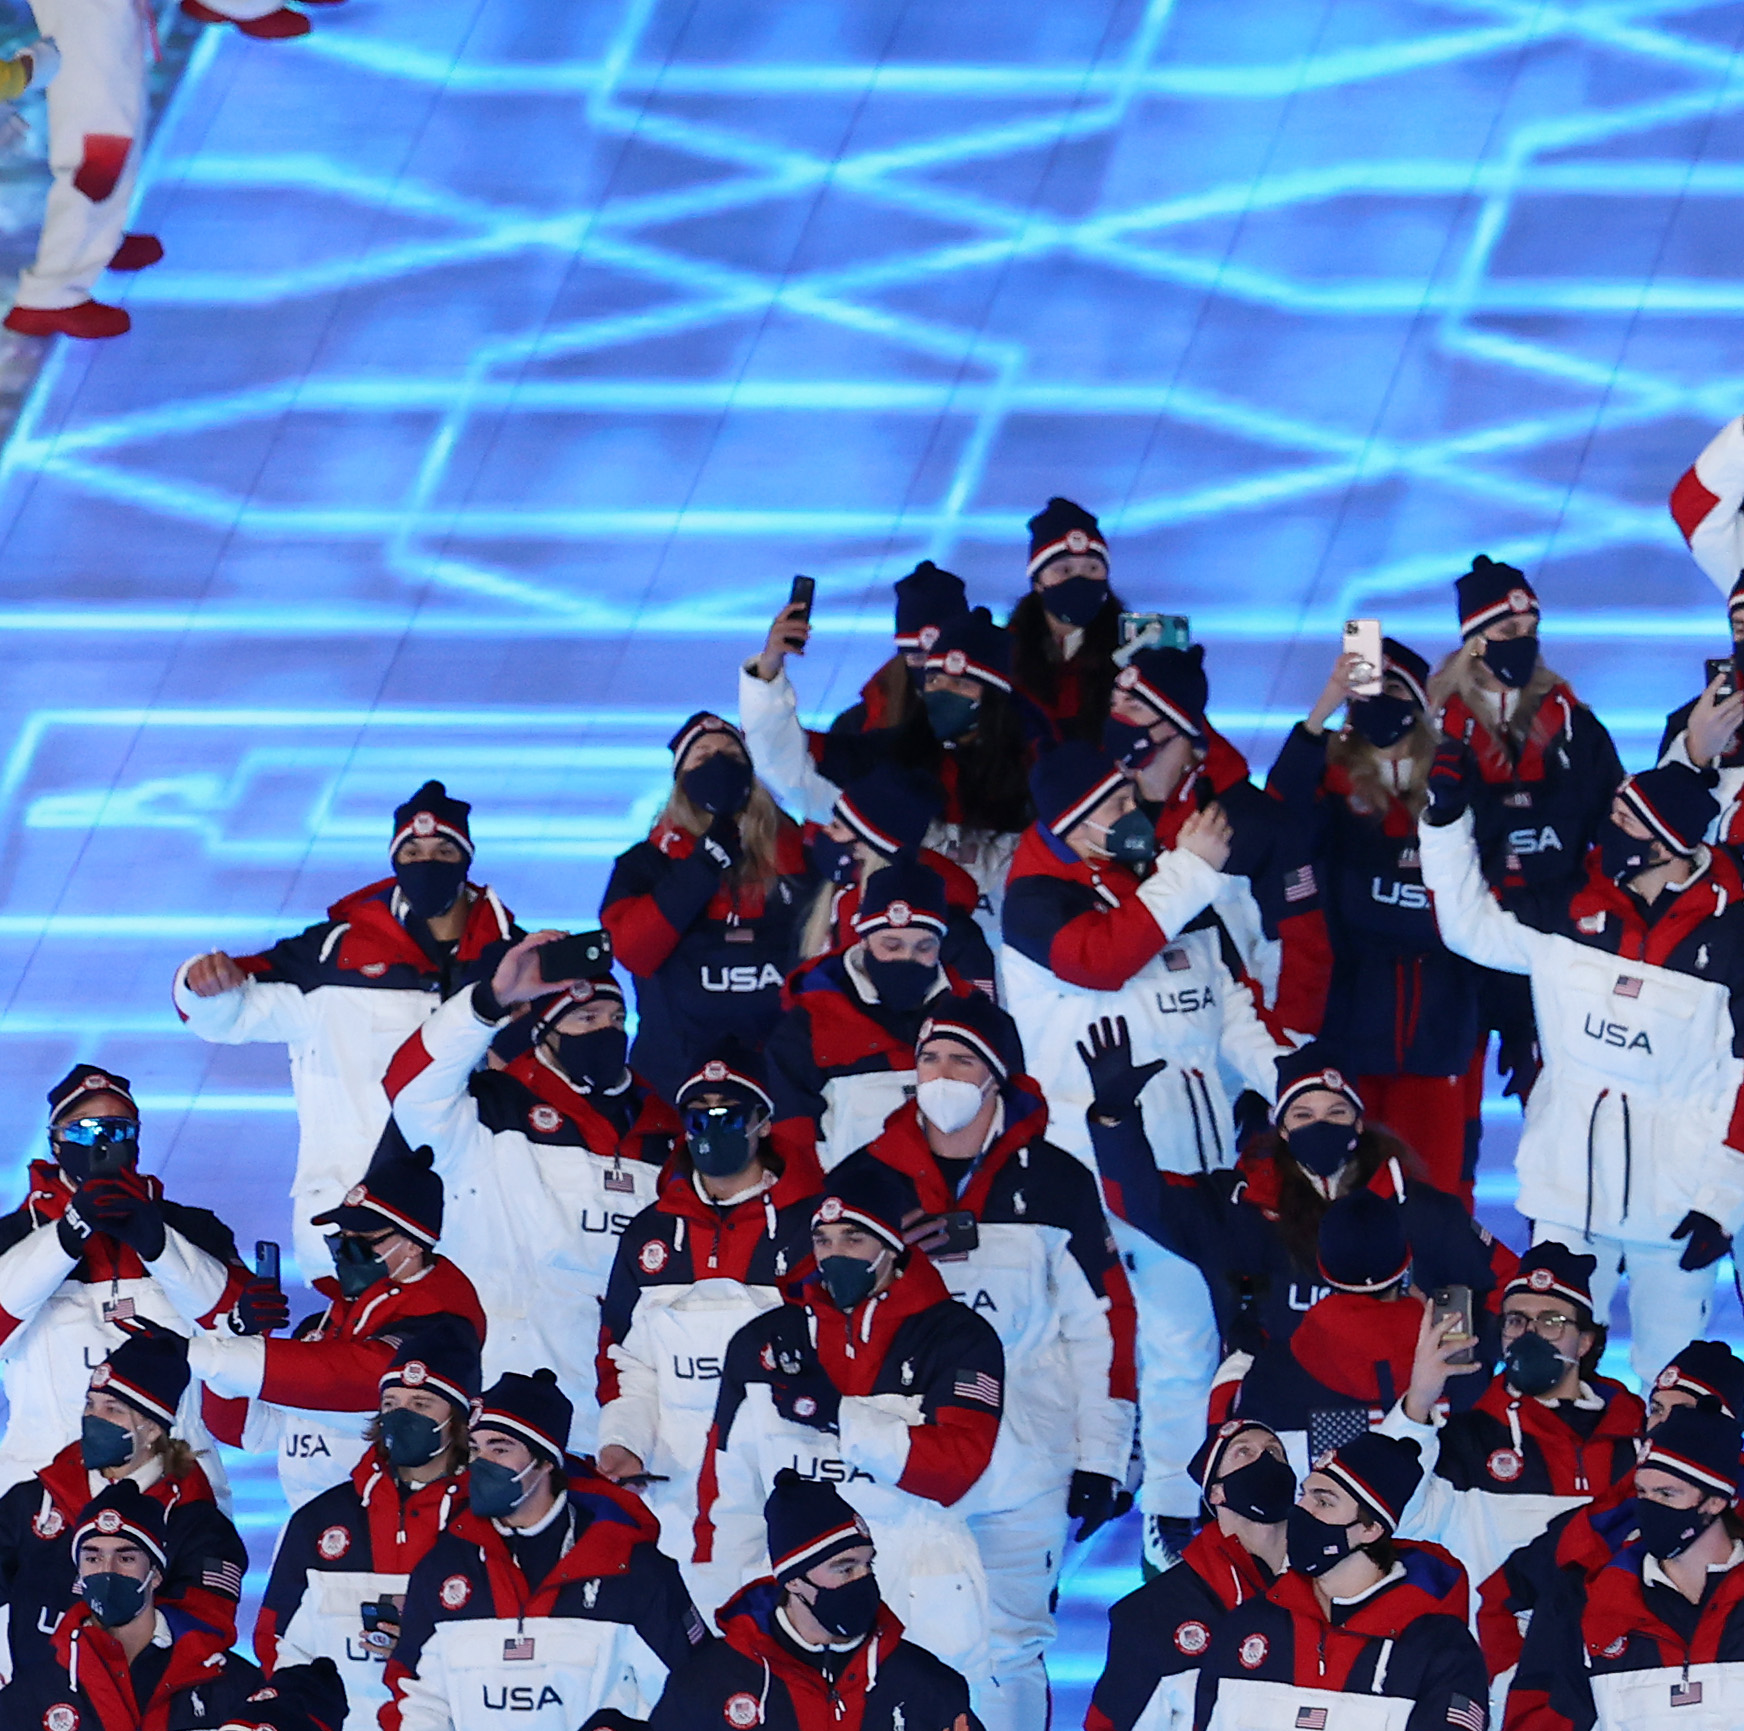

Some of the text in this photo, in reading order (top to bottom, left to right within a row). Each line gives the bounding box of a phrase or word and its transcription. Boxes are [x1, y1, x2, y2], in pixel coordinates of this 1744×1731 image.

[1509, 828, 1561, 853] SA
[1372, 877, 1428, 908] US
[701, 965, 784, 992] USA
[1156, 987, 1214, 1014] USA
[1584, 1012, 1652, 1053] USA
[582, 1209, 630, 1234] US
[674, 1355, 722, 1380] US
[286, 1434, 330, 1458] USA
[483, 1684, 562, 1711] USA
